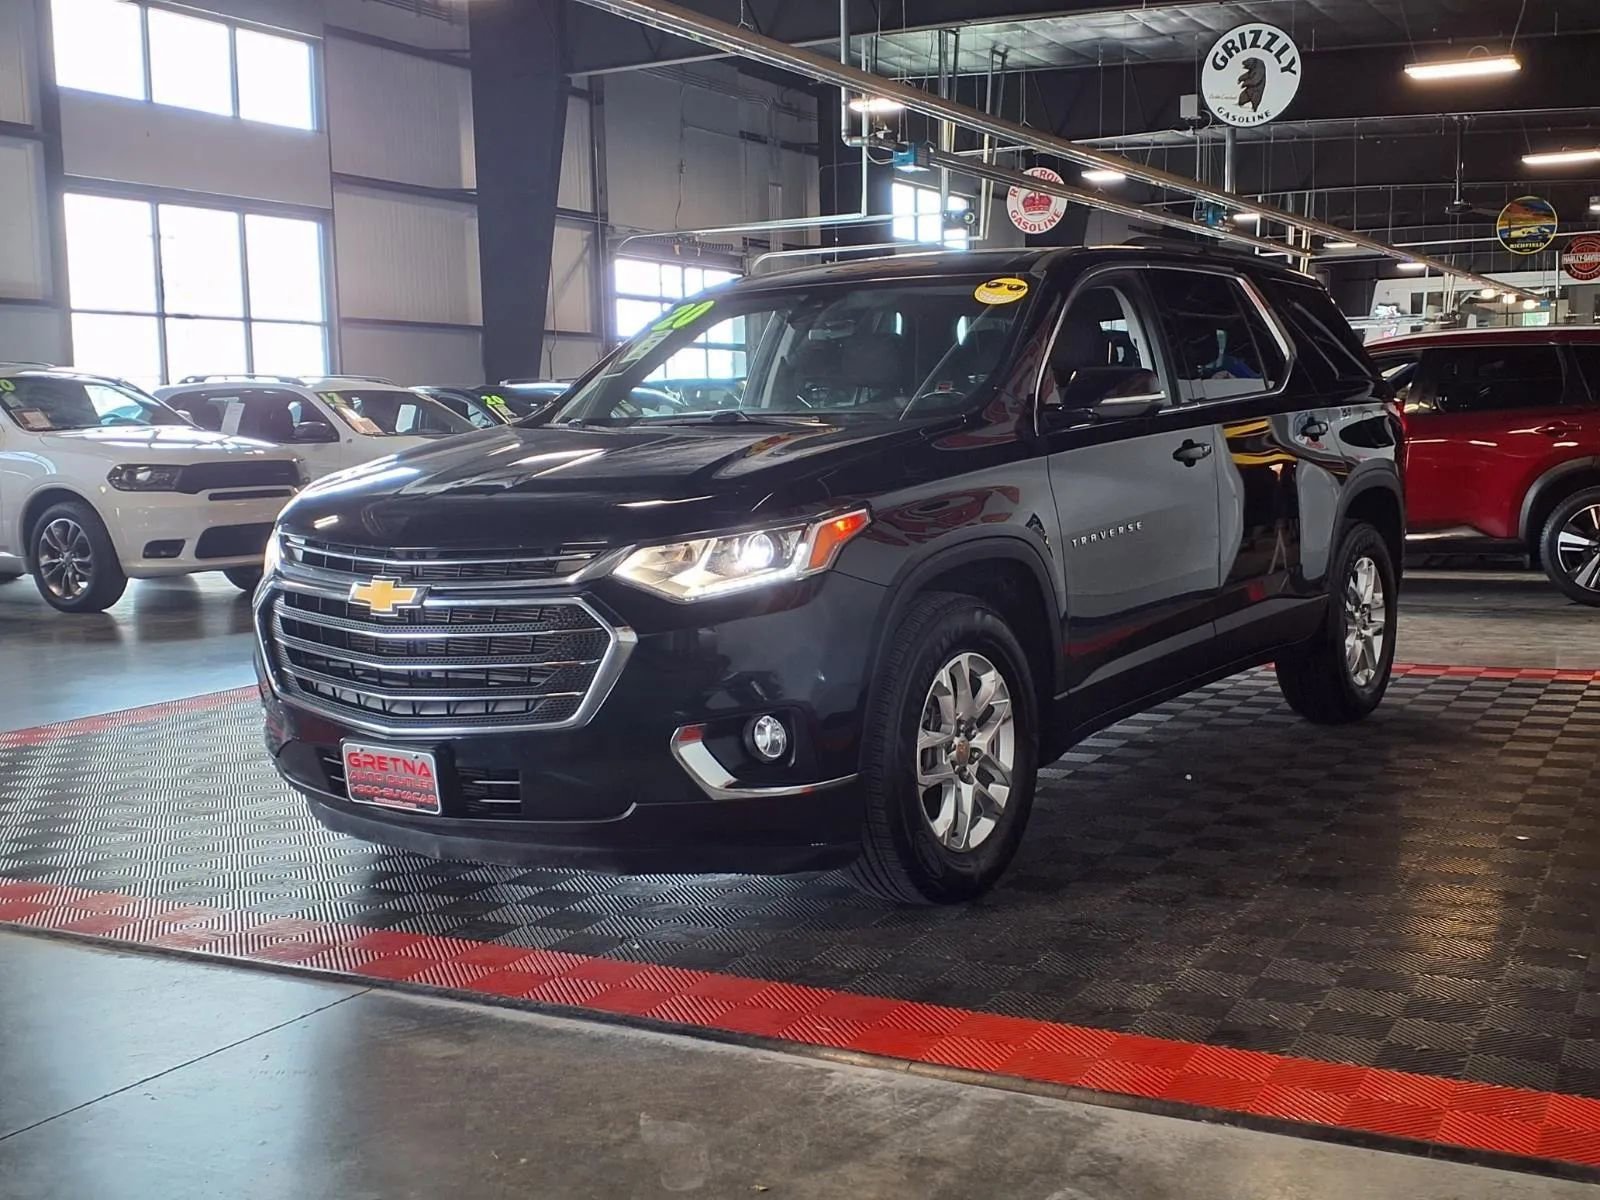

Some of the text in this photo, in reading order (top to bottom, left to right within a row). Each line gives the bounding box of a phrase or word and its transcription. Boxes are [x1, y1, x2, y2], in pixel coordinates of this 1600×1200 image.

[1212, 29, 1297, 75] GRIZZLY
[1217, 106, 1271, 123] GASOLINE
[1010, 208, 1062, 231] GASOLINE
[1072, 521, 1143, 548] TRAVERSE
[347, 752, 433, 777] GRETNA
